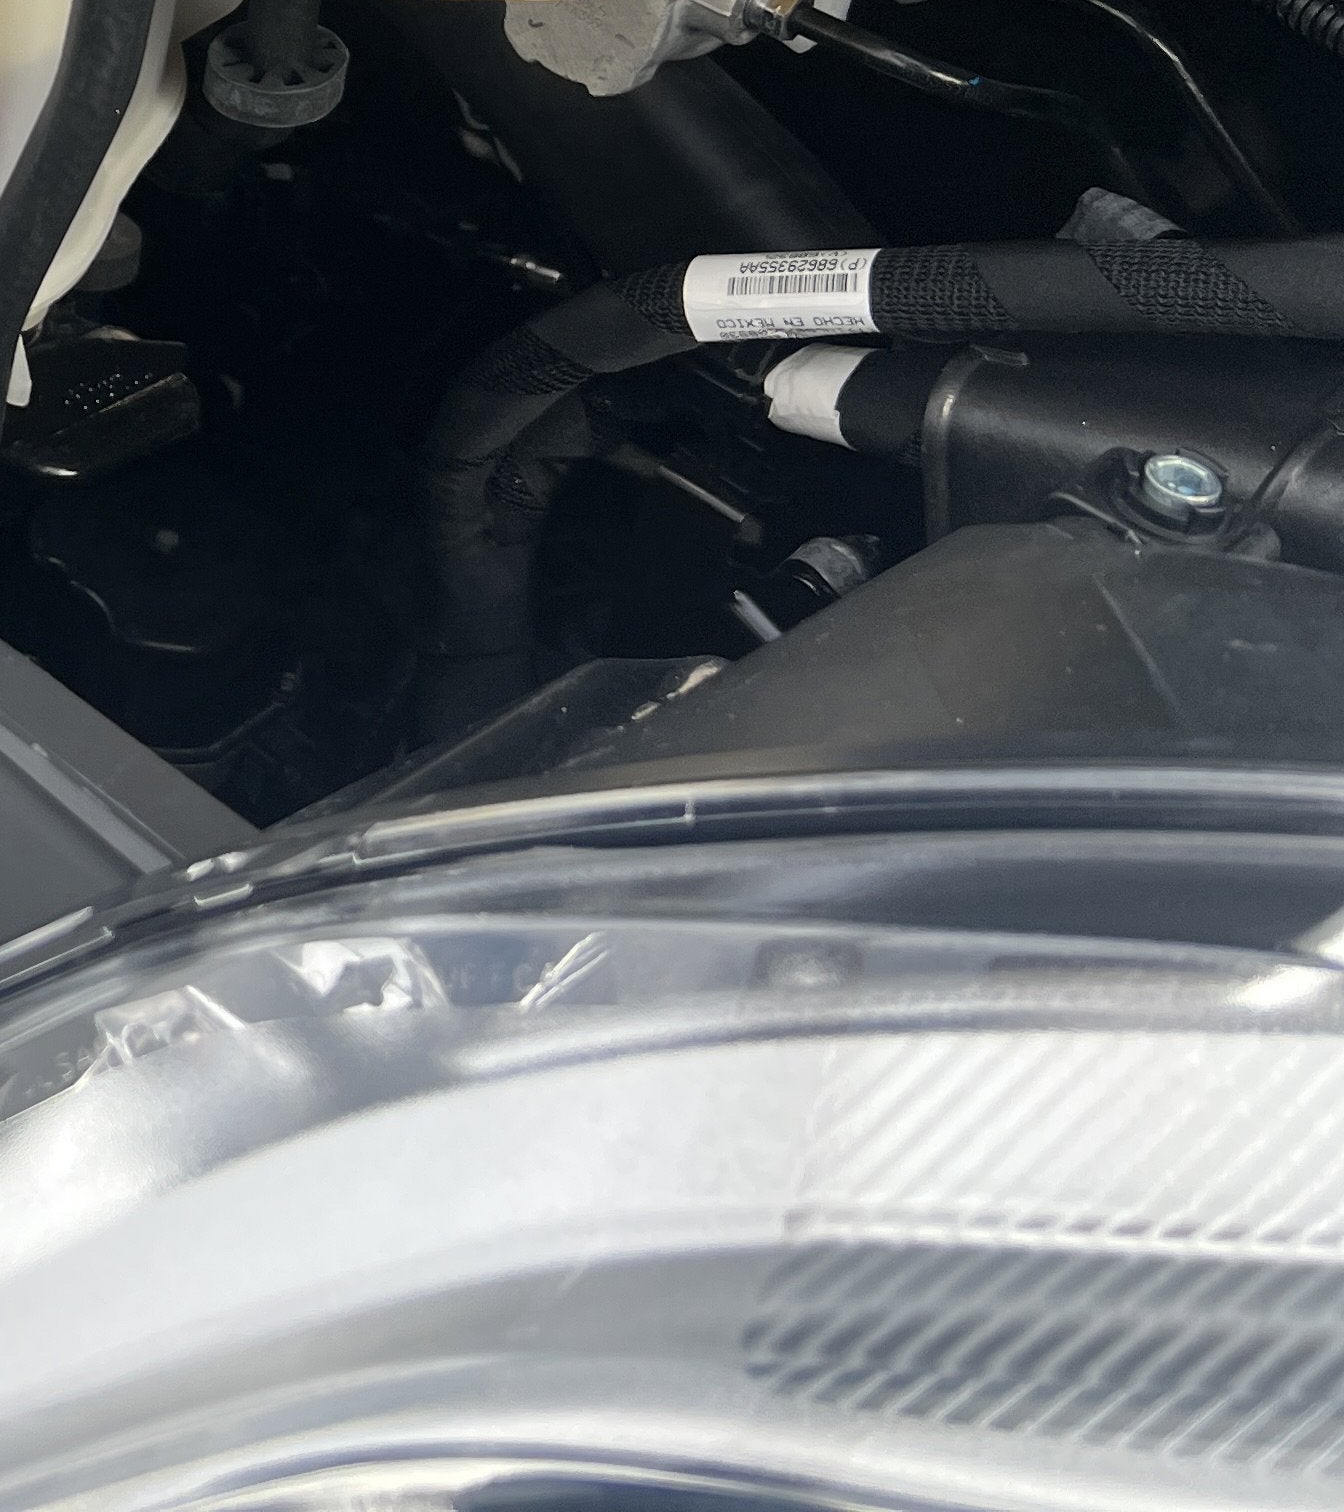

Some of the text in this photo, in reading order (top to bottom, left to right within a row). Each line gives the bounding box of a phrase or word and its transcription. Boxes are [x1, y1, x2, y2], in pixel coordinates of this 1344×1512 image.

[716, 315, 864, 329] HECHO EN MEXICO
